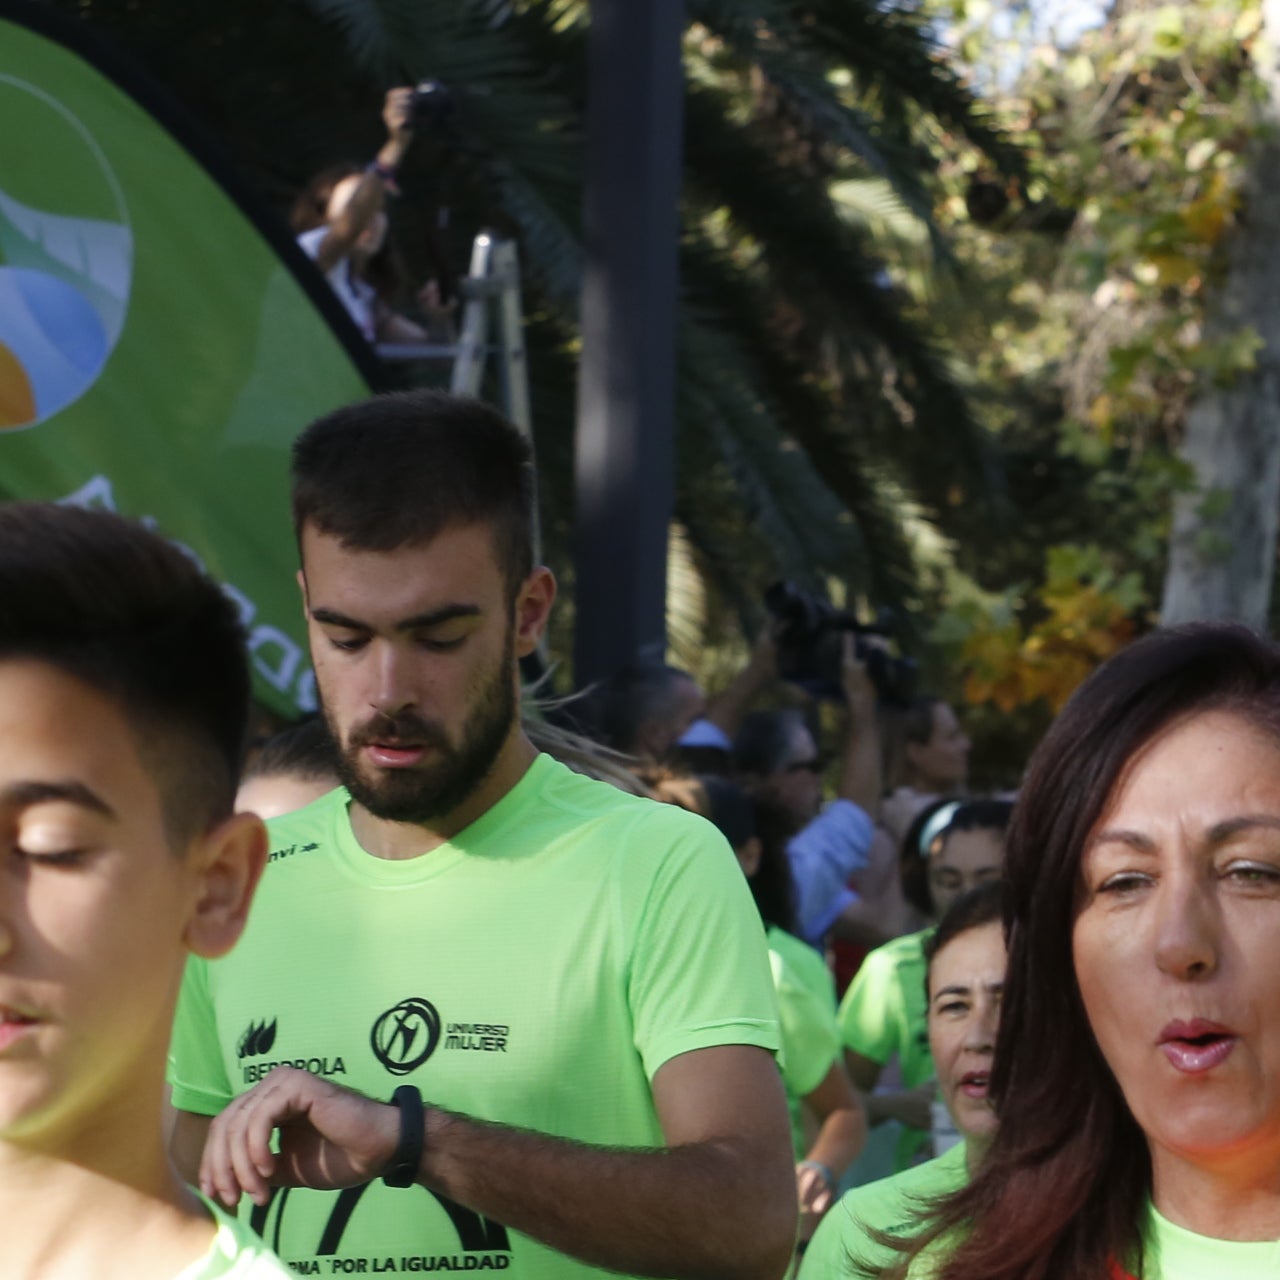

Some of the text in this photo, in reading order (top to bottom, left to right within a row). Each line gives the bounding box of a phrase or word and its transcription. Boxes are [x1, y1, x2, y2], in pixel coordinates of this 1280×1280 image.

[447, 1023, 509, 1036] UNIVERSO
[444, 1035, 507, 1052] MUJER
[372, 1257, 397, 1272] LA
